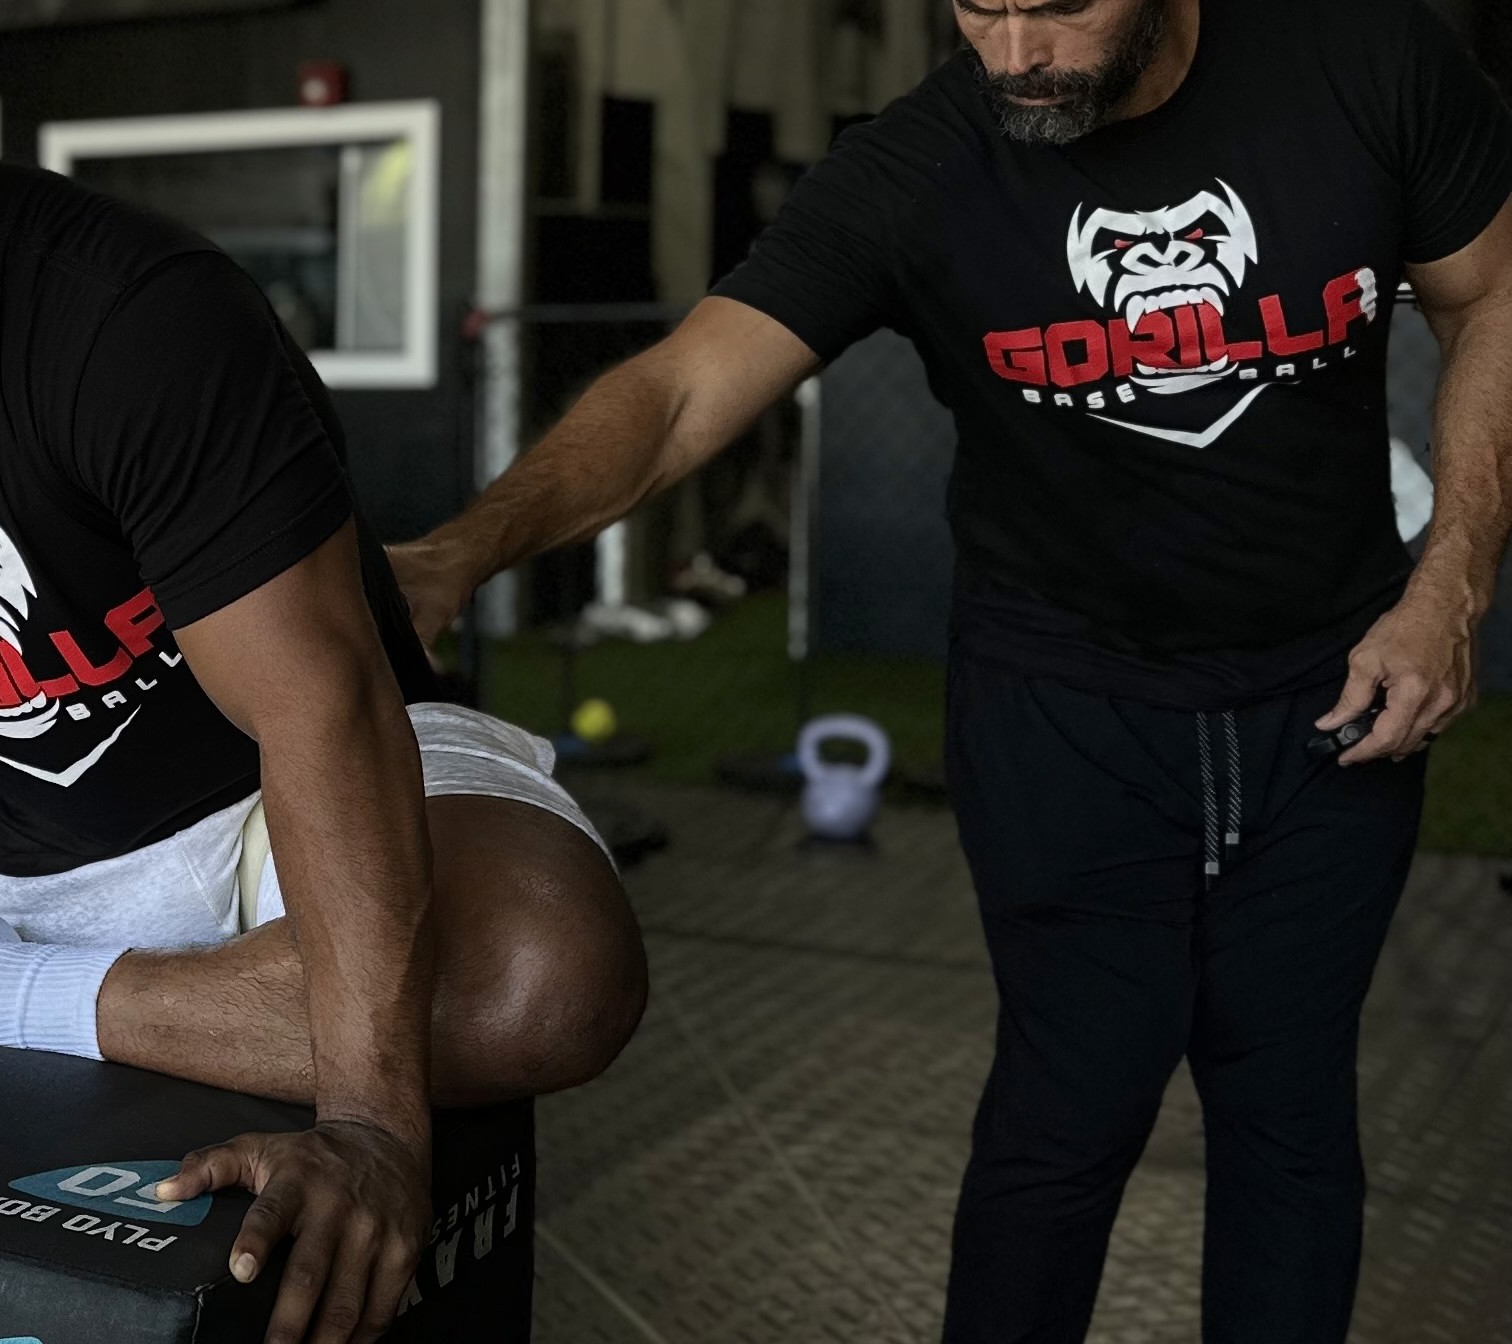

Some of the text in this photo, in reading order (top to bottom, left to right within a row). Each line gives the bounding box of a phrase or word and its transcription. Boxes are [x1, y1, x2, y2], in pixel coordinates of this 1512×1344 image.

[983, 267, 1377, 388] GORILLA
[61, 1214, 178, 1252] PLYO
[428, 1152, 521, 1245] FITNES
